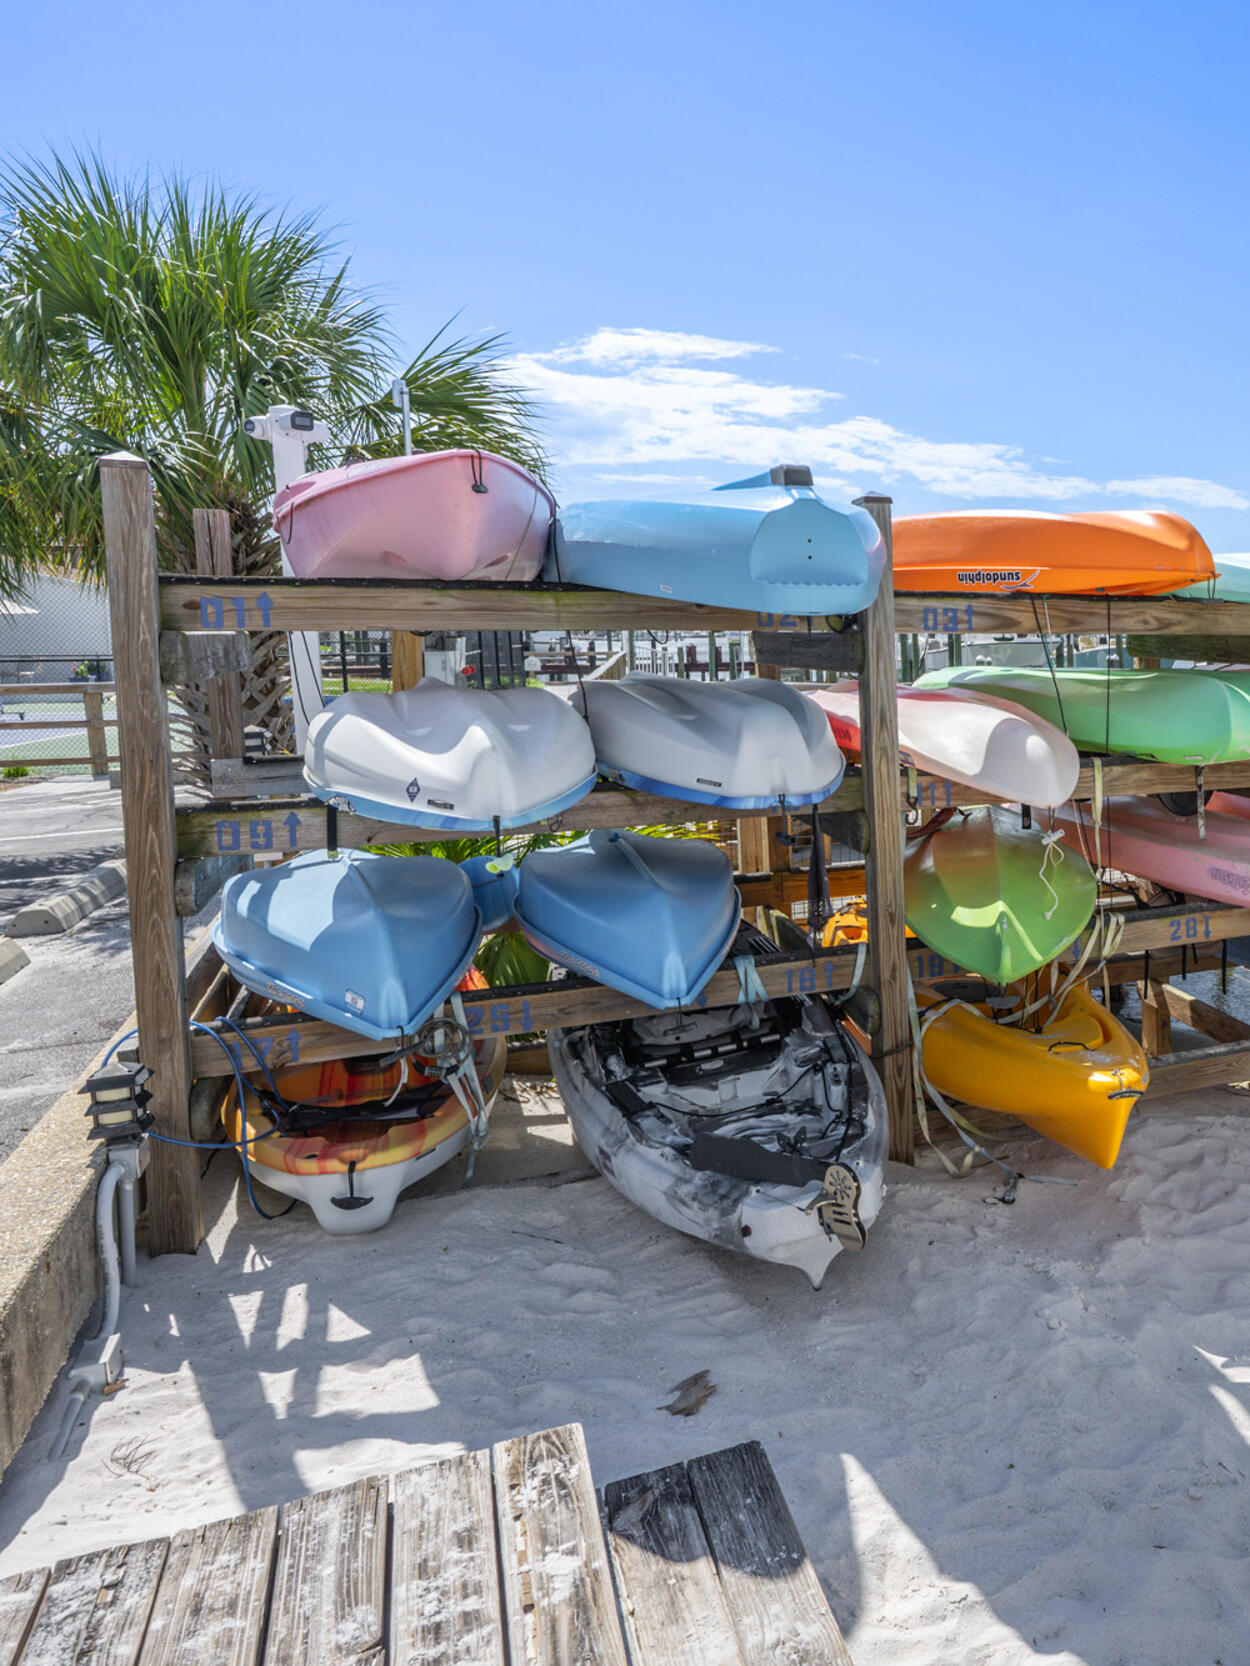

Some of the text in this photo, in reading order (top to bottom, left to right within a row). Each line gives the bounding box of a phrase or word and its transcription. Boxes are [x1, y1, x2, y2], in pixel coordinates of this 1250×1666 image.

[957, 570, 1021, 585] sundolphin
[200, 596, 246, 630] 01
[923, 607, 959, 632] 03
[216, 820, 274, 851] 09
[1169, 918, 1198, 941] 28
[465, 1003, 511, 1035] 25
